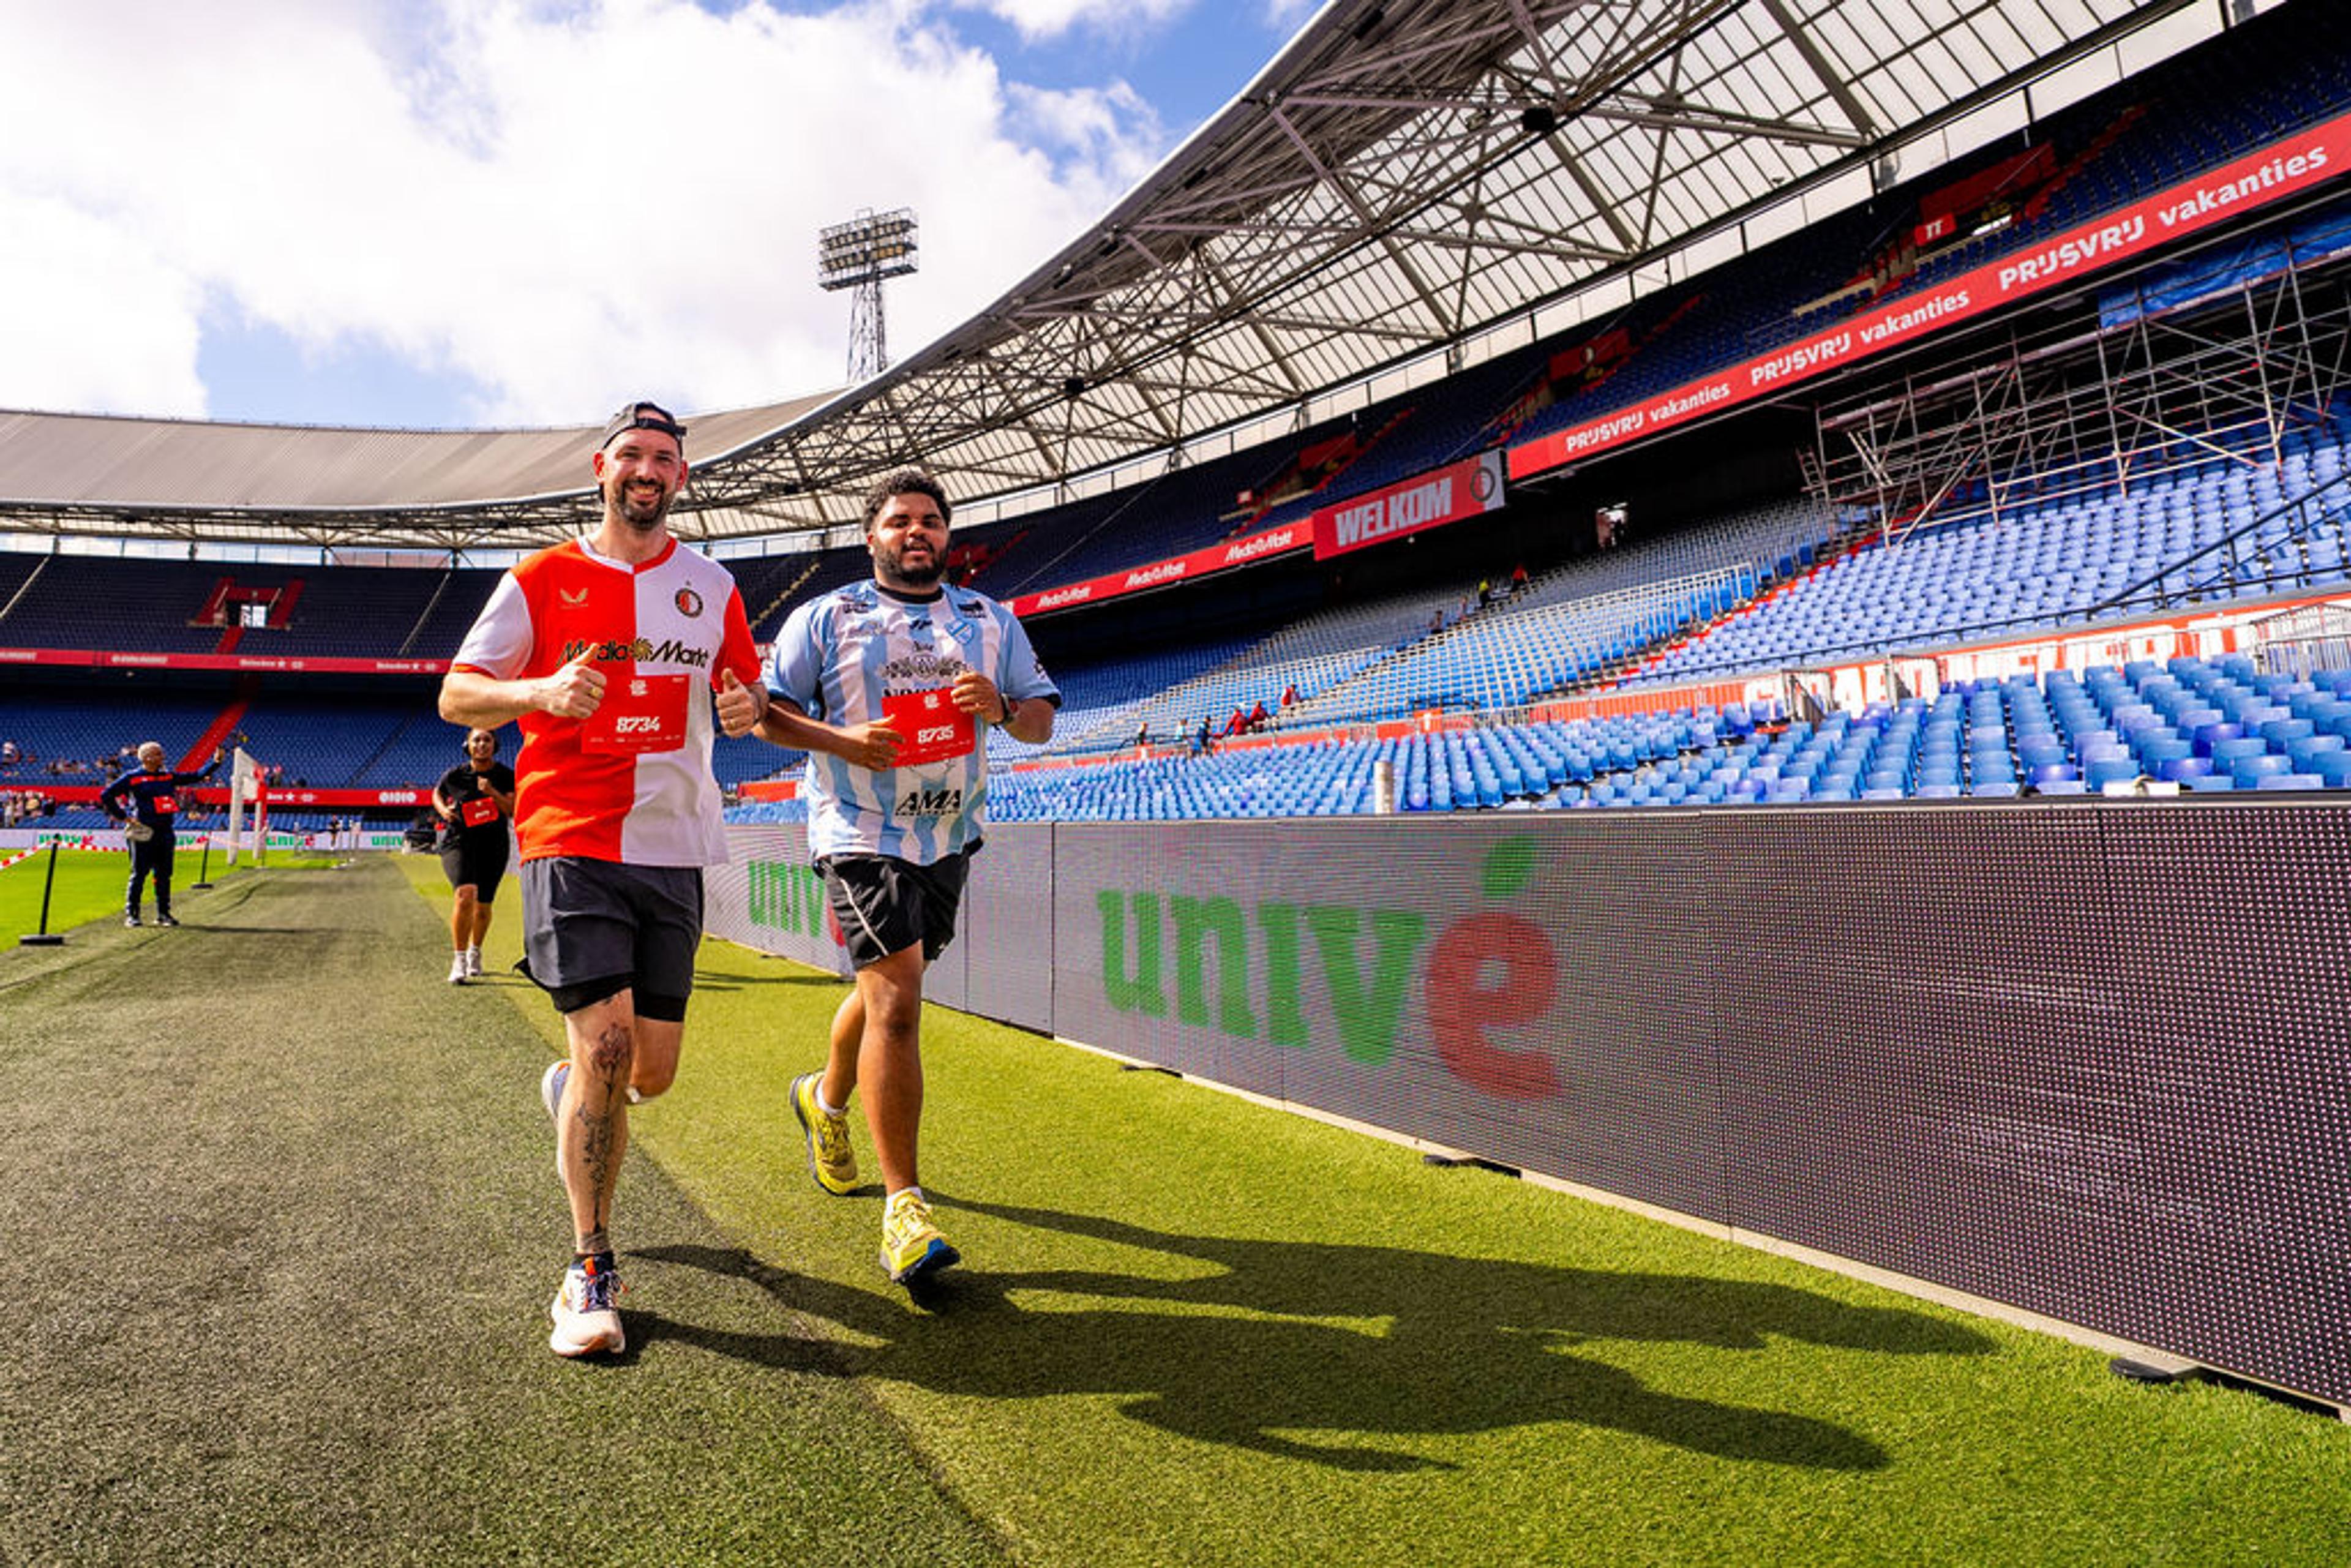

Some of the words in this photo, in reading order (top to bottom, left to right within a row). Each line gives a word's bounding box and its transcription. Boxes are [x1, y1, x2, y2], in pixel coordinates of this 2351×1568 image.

[1999, 216, 2145, 291] PRIJSVRIJ
[2158, 146, 2328, 227] vakanties
[1750, 332, 1851, 386] PRIJSVRIJ
[1860, 291, 1970, 343] vakanties
[1565, 411, 1644, 452] PRIJSVRIJ
[1650, 383, 1731, 422] vakanties
[1334, 476, 1452, 547] WELKOM
[616, 716, 661, 733] 8734
[918, 724, 954, 744] 8735
[896, 790, 961, 812] AMA
[372, 835, 402, 846] univ
[1097, 835, 1561, 1101] univé
